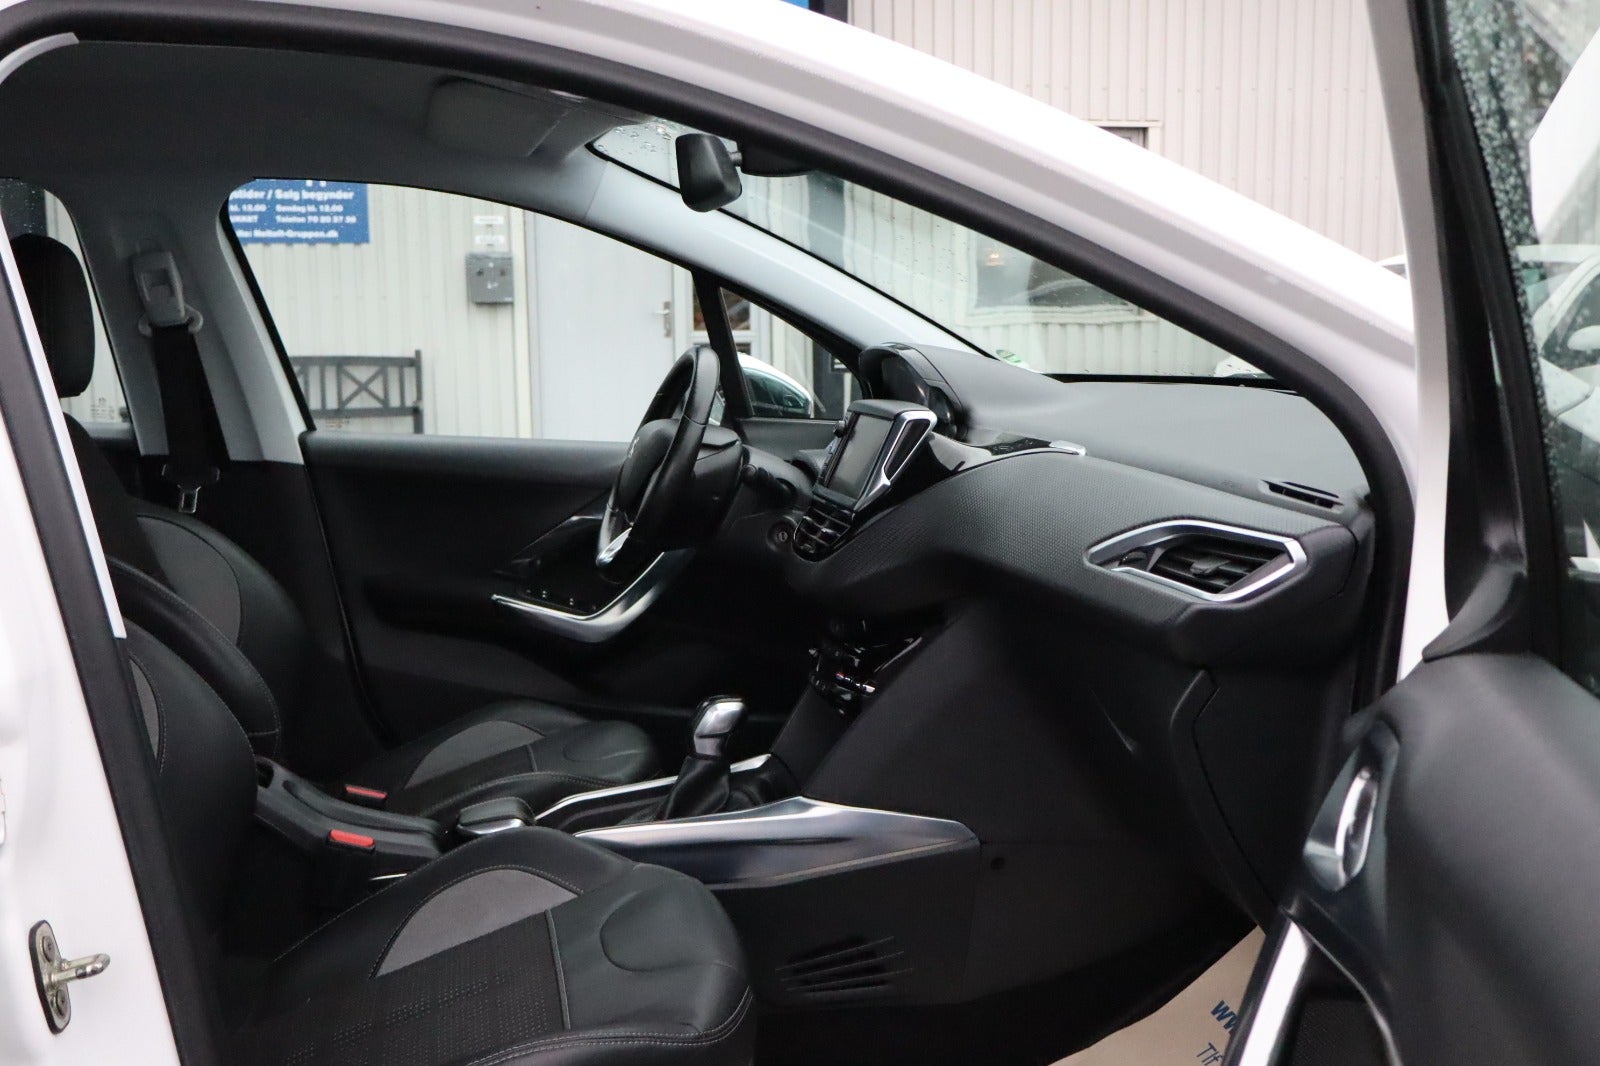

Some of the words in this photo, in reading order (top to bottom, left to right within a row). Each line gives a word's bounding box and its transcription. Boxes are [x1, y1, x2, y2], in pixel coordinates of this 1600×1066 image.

[267, 189, 273, 201] /
[274, 188, 300, 202] Salg
[301, 188, 355, 202] begynder
